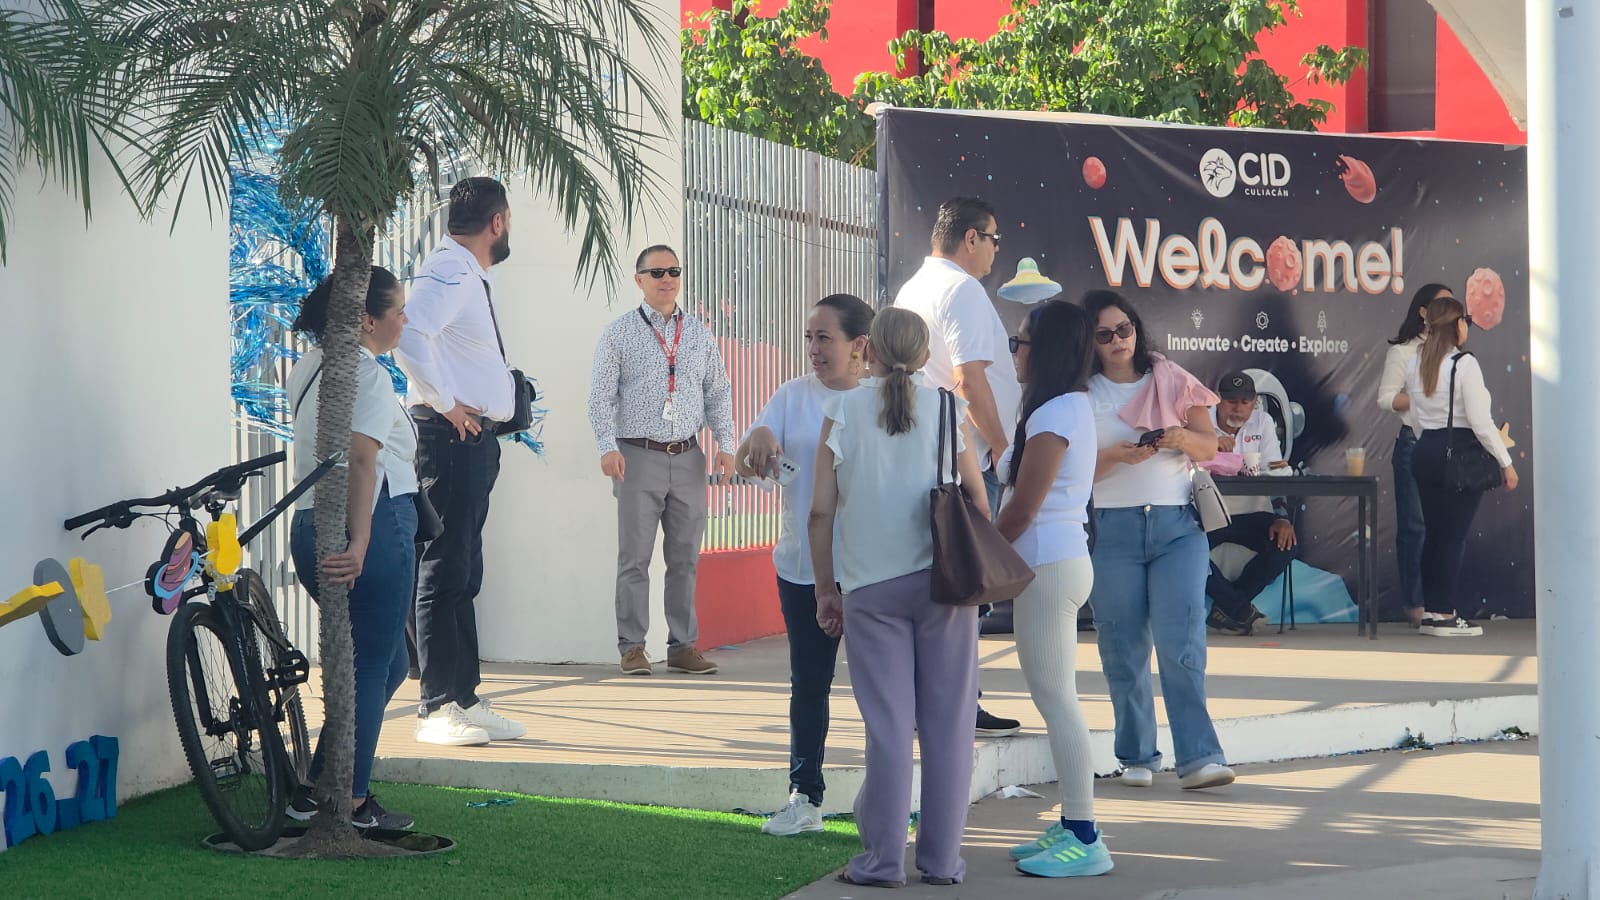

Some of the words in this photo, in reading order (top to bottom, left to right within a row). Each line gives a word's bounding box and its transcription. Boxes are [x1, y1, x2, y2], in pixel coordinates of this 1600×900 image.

[1239, 152, 1291, 187] CID
[1244, 187, 1289, 197] CULIACÁN
[1088, 216, 1404, 295] Welcome!
[1167, 333, 1230, 352] Innovate
[1240, 335, 1289, 353] Create
[1300, 336, 1349, 356] Explore
